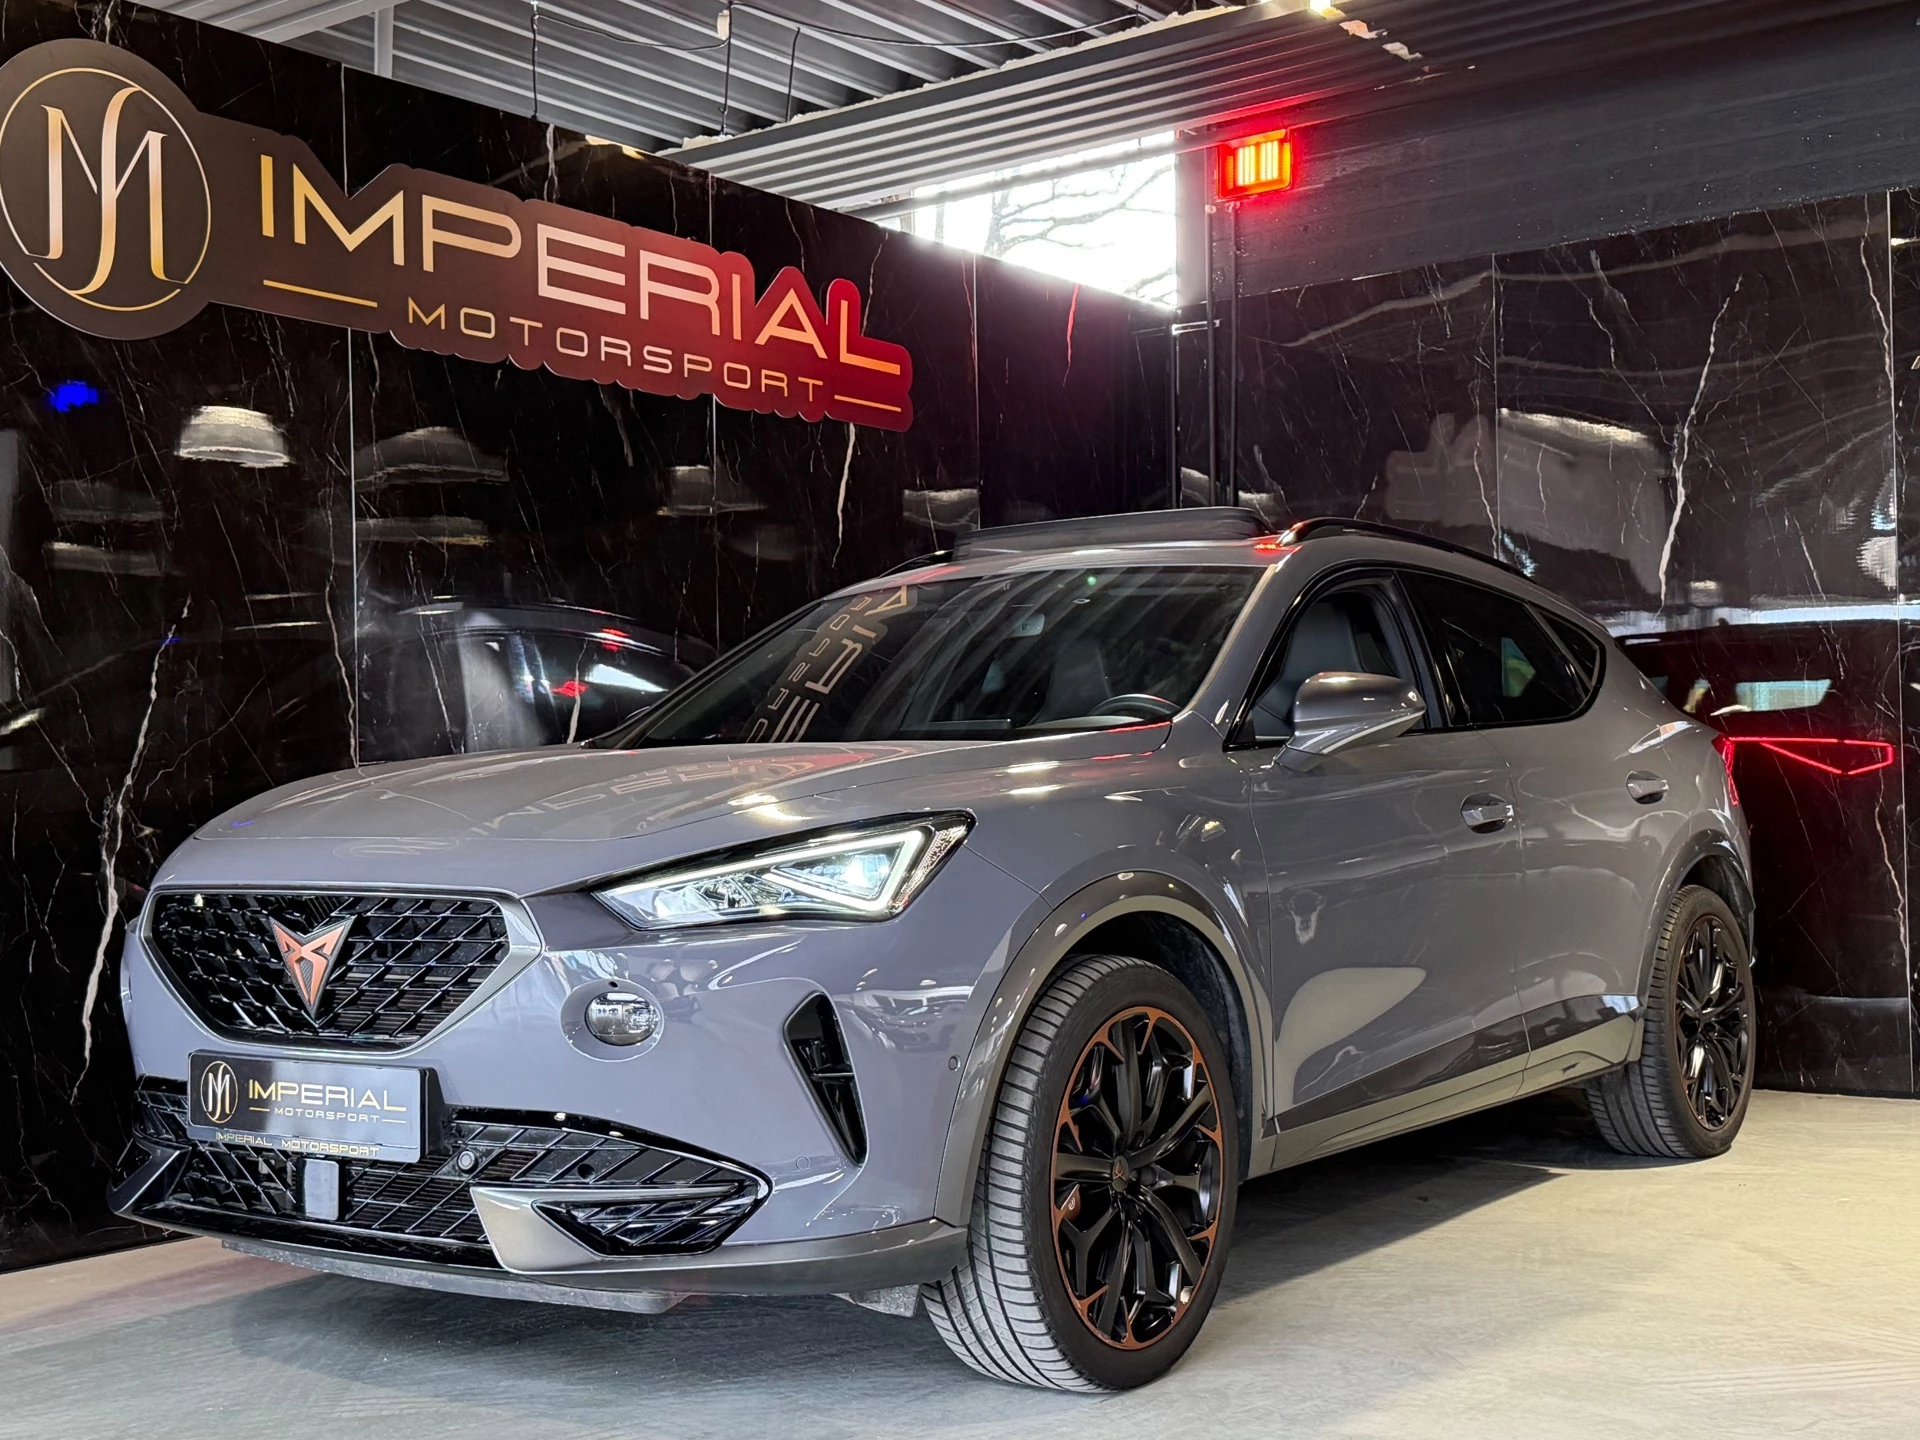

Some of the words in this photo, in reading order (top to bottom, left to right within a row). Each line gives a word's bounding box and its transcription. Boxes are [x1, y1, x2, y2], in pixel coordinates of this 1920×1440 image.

[261, 154, 901, 376] IMPERIAL
[407, 296, 824, 403] MOTORSPORT
[248, 1078, 407, 1112] IMPERIAL
[274, 1106, 380, 1124] MOTORSPORT
[215, 1131, 273, 1146] IMPERIAL
[281, 1139, 380, 1157] MOTORSPORT
